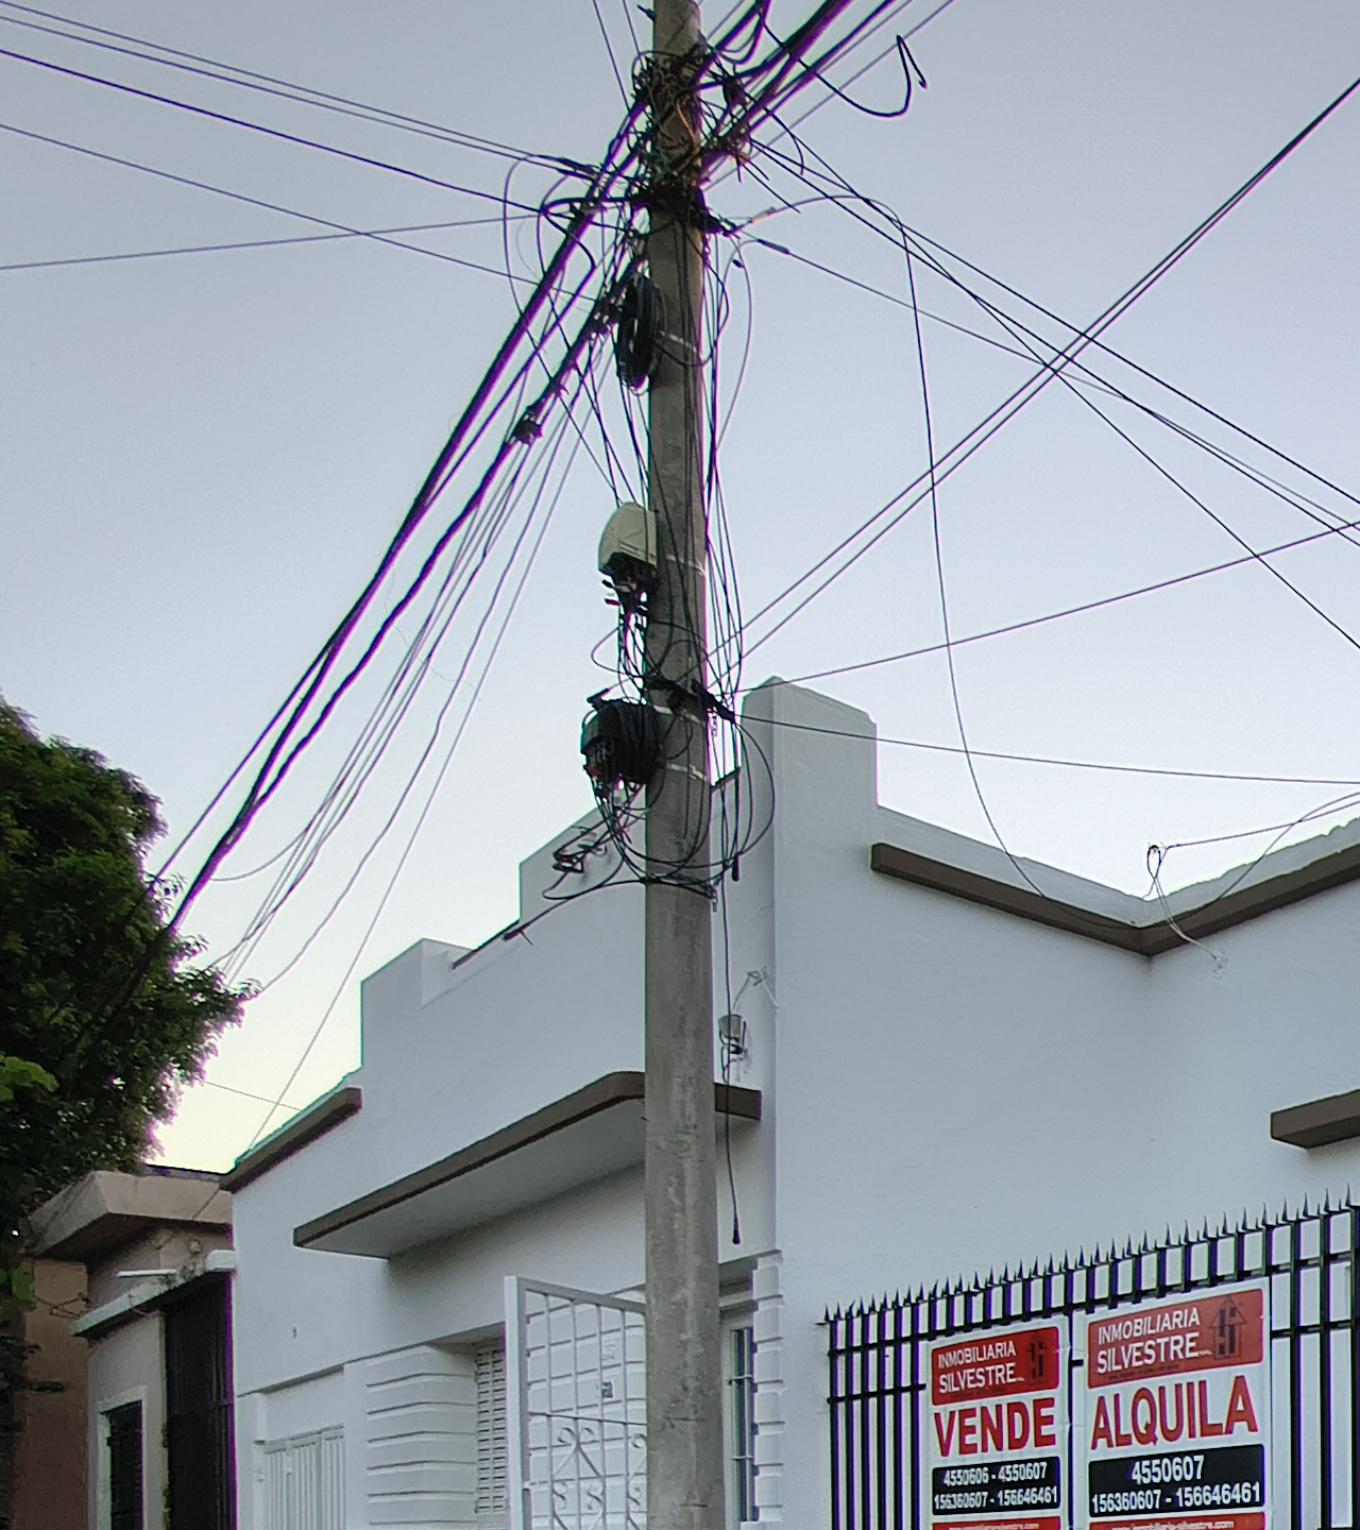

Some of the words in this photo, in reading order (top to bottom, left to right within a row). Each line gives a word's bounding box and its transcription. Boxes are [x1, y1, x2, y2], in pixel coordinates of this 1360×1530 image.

[1098, 1307, 1200, 1346] INMOBILIARIA
[938, 1340, 1016, 1369] INMOBILIARIA
[1096, 1331, 1200, 1375] SILVESTRE
[939, 1362, 1017, 1394] SILVESTRE
[934, 1397, 1056, 1457] VENDE
[1090, 1375, 1258, 1451] ALQUILA
[943, 1466, 989, 1487] 4550606
[998, 1461, 1047, 1482] 4550607
[1131, 1454, 1205, 1485] 4550607
[997, 1485, 1057, 1507] 156646461
[1092, 1488, 1162, 1514] 156360607
[1176, 1480, 1260, 1508] 156646461
